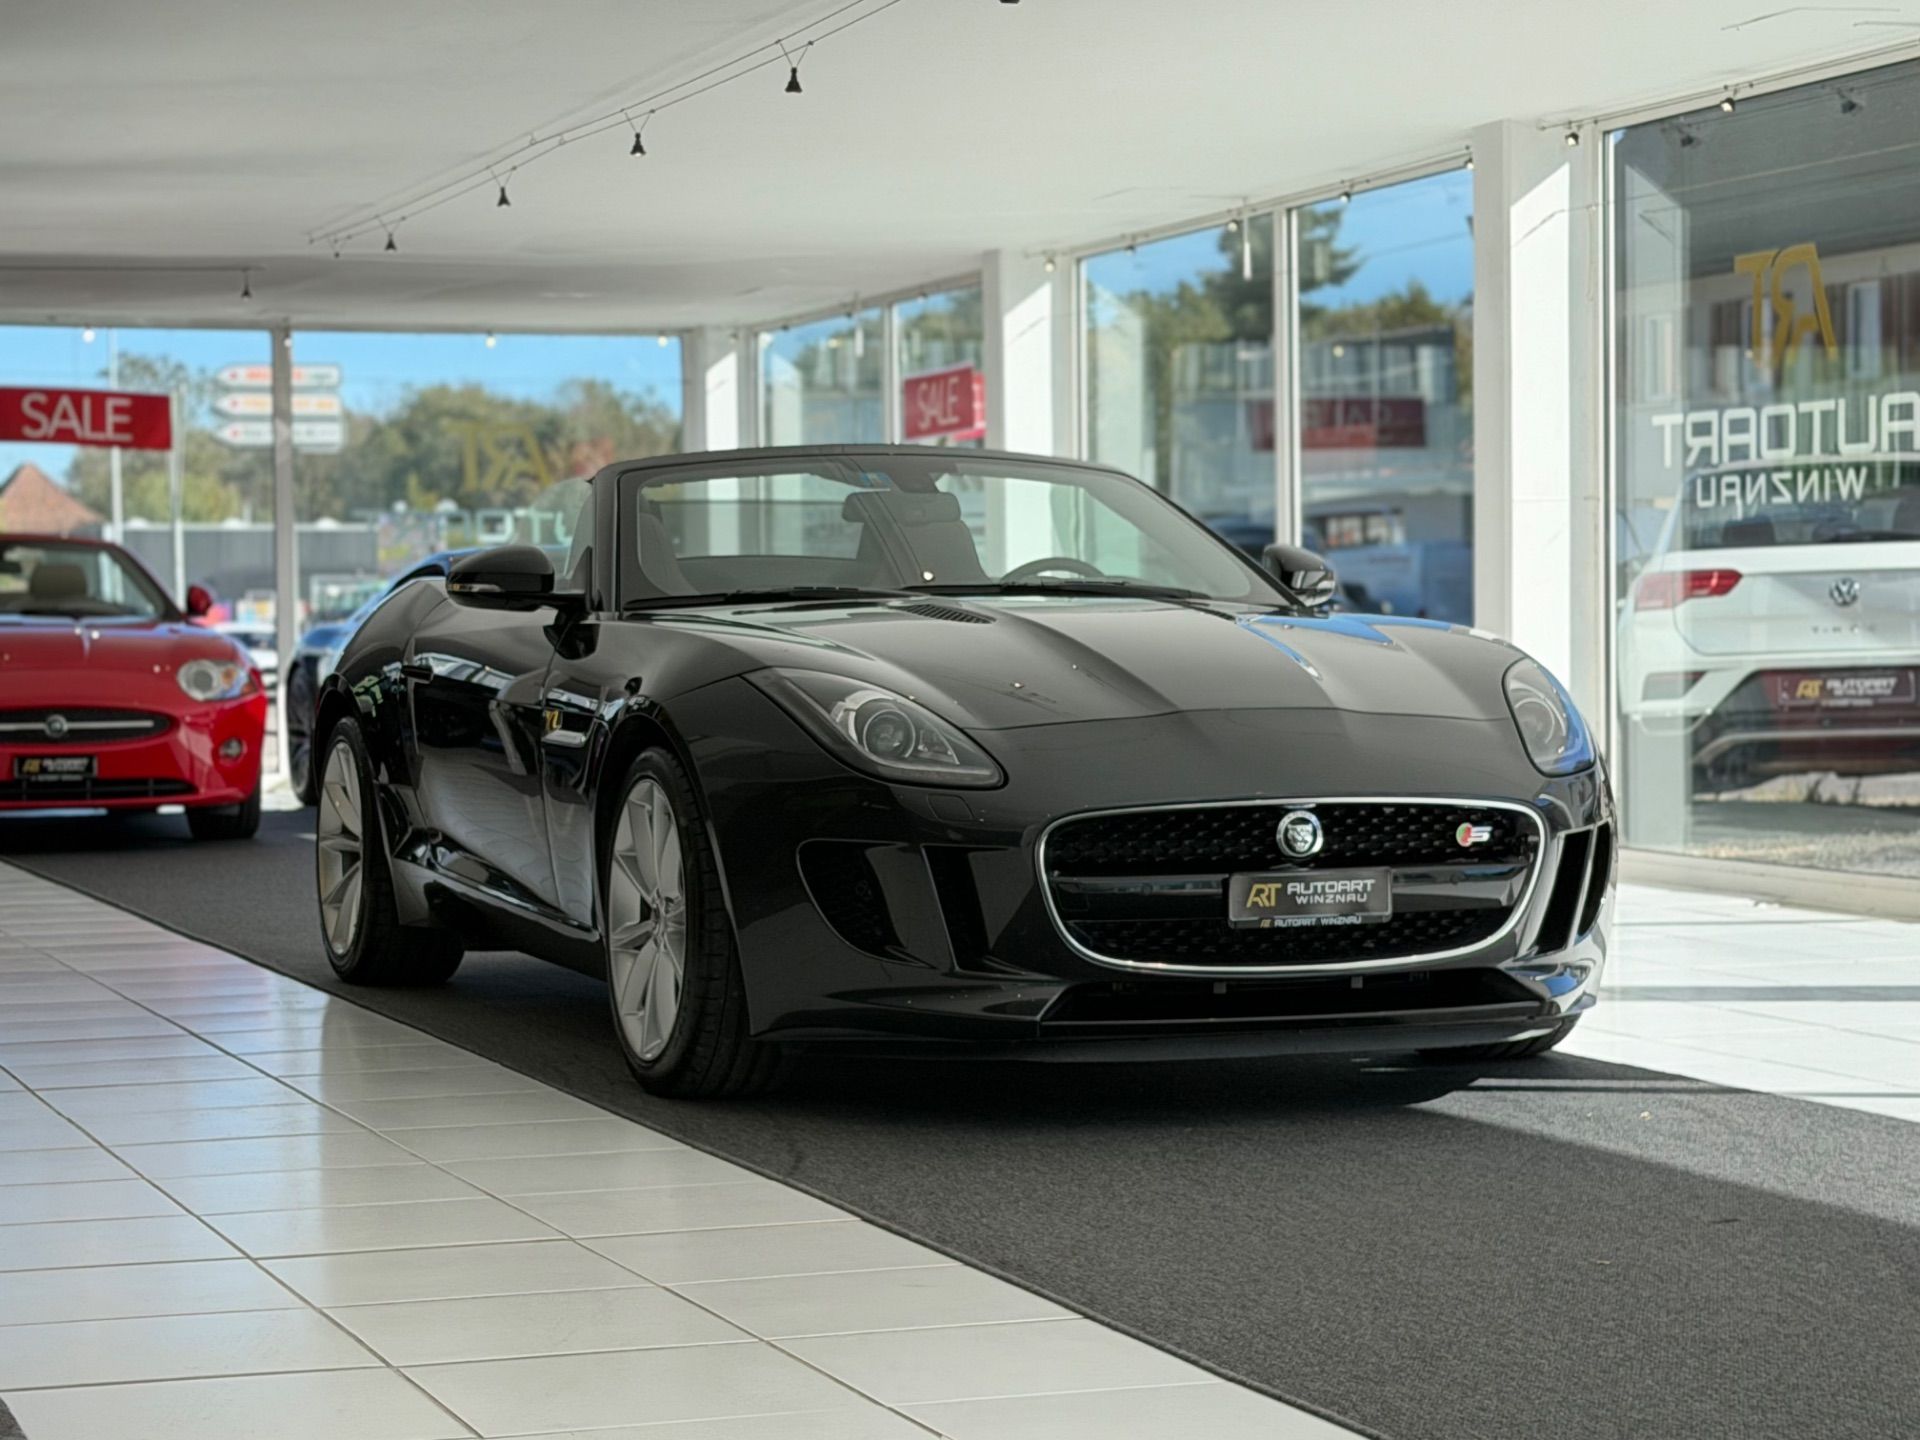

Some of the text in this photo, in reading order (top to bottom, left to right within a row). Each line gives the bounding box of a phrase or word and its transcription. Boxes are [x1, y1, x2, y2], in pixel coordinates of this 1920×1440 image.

[917, 376, 960, 431] SALE
[20, 391, 135, 443] SALE
[1287, 879, 1376, 895] AUTOART
[1295, 892, 1368, 905] WINZNAU
[1274, 917, 1316, 928] AUTOART
[1320, 915, 1362, 925] WINZNAU
